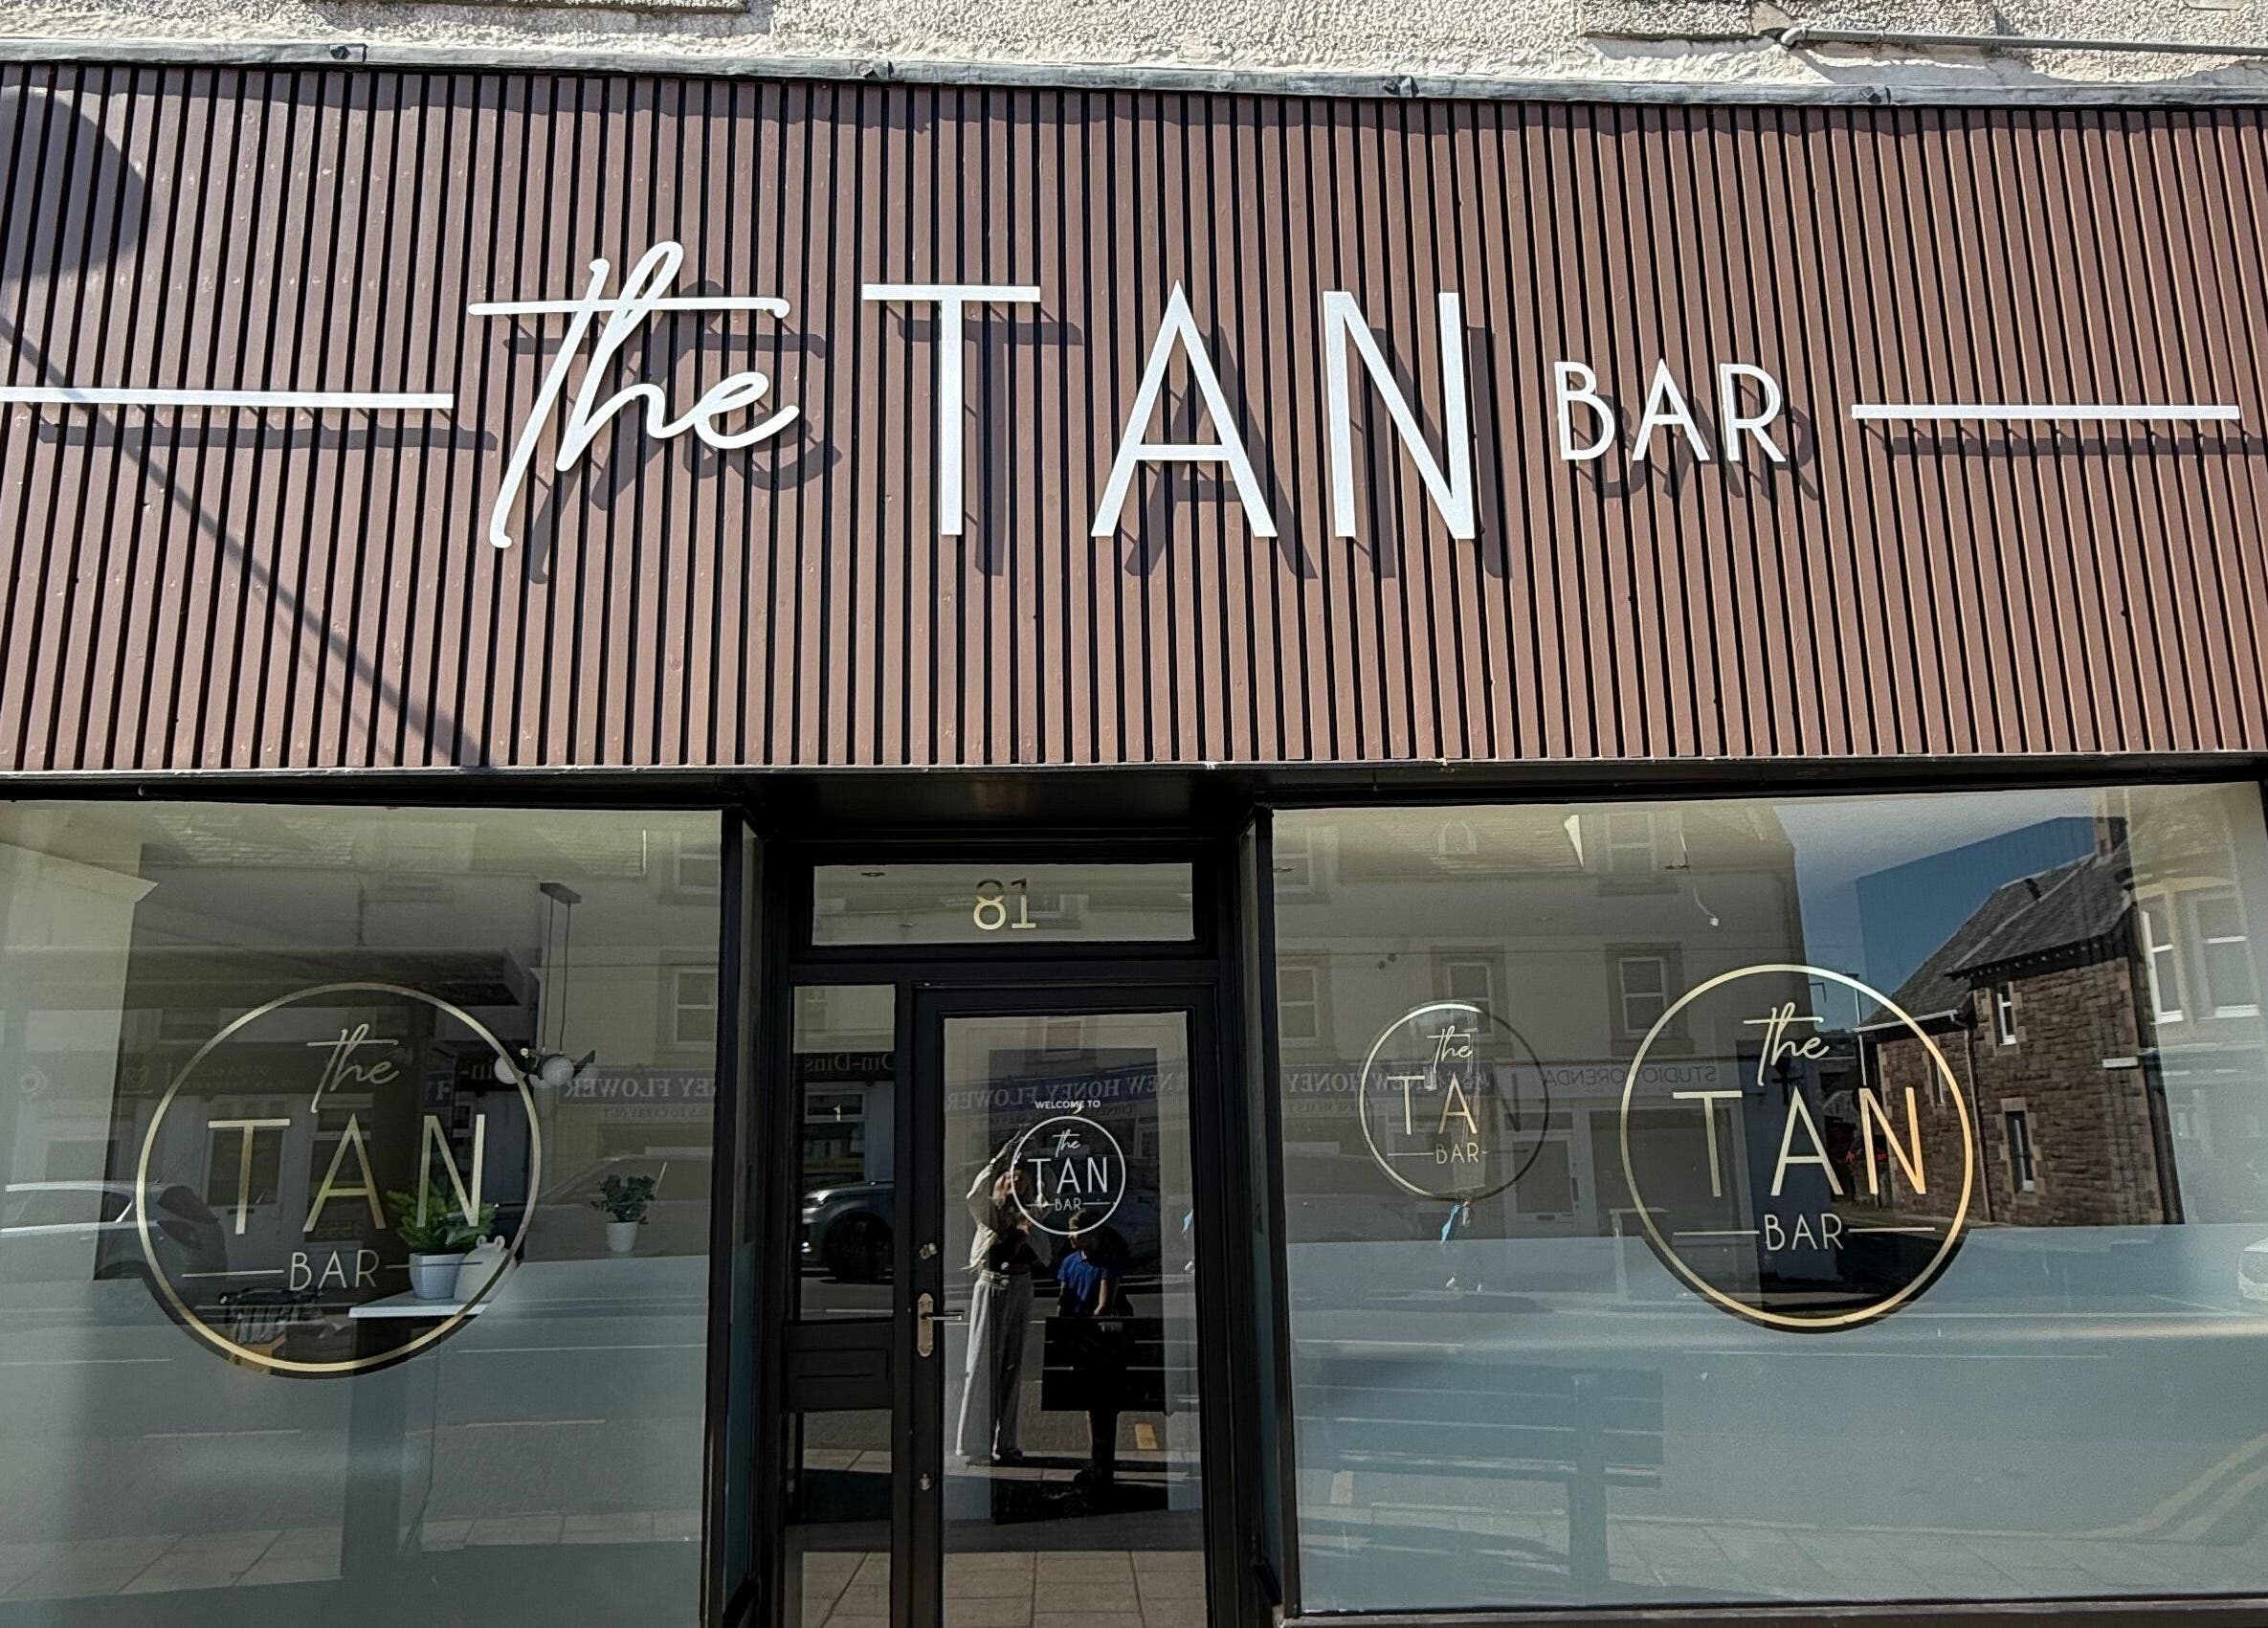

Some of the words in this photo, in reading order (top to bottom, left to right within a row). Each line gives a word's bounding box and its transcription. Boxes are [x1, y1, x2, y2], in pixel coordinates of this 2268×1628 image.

[468, 240, 800, 549] the
[862, 279, 1476, 541] TAN
[1554, 358, 1787, 463] BAR
[972, 878, 1036, 930] 81
[1425, 1024, 1474, 1073] the
[1743, 1001, 1830, 1087] the
[306, 1022, 399, 1114] the
[1034, 1099, 1085, 1110] WELCOME
[1086, 1099, 1101, 1109] TO
[1051, 1127, 1081, 1158] the
[1434, 1141, 1480, 1165] BAR
[1672, 1084, 1927, 1199] TAN
[208, 1112, 486, 1236] TAN
[1026, 1155, 1108, 1194] TAN
[1054, 1197, 1082, 1212] BAR
[1763, 1213, 1845, 1252] BAR
[289, 1249, 380, 1291] BAR
